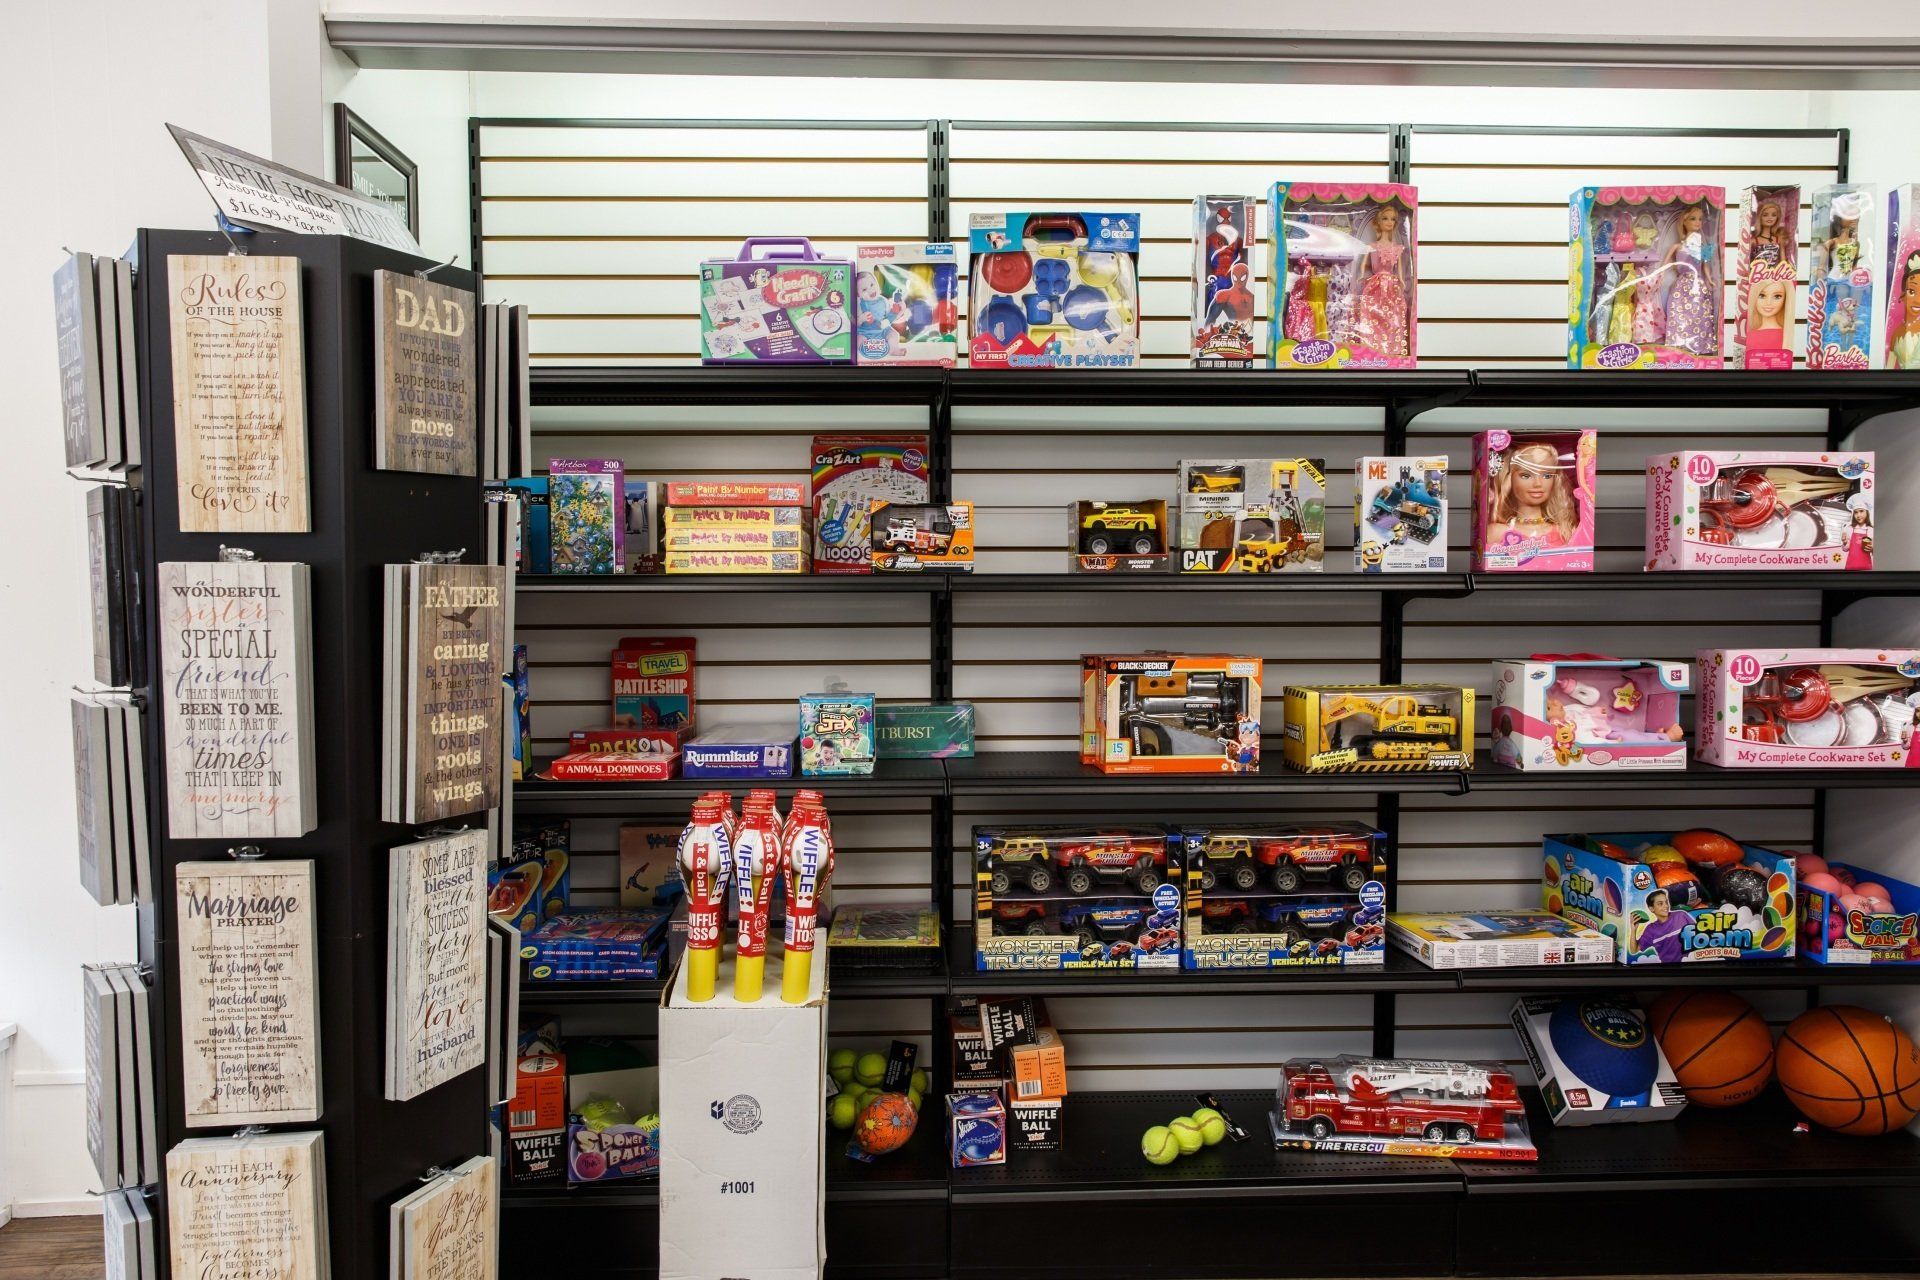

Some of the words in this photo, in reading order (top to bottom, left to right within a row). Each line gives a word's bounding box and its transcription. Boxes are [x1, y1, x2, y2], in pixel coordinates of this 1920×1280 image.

[215, 176, 279, 203] Assorted
[859, 247, 894, 256] Fisher-Price
[1752, 262, 1795, 282] Barbie
[181, 274, 286, 306] Rules
[773, 275, 817, 292] Needle
[186, 307, 203, 315] OF
[208, 307, 234, 315] THE
[240, 308, 282, 316] HOUSE
[395, 289, 465, 337] DAD
[776, 313, 782, 321] 6
[1806, 280, 1827, 369] Barbie
[403, 348, 459, 367] wondered
[1293, 343, 1329, 357] Fashion
[1600, 348, 1635, 358] Fashion
[1825, 346, 1865, 365] Barbie
[1008, 355, 1072, 367] CREATIVE
[1076, 355, 1134, 367] PLAYSET
[1305, 352, 1328, 365] Girls
[1610, 356, 1633, 367] Girls
[411, 419, 454, 437] more
[604, 461, 619, 469] 500
[1369, 464, 1387, 479] ME
[1692, 458, 1711, 475] 10
[1664, 470, 1672, 487] My
[697, 485, 717, 493] Paint
[721, 485, 732, 495] By
[1655, 466, 1664, 532] Cookware
[1662, 491, 1671, 552] Complete
[826, 546, 861, 560] 1000
[1654, 534, 1663, 556] Set
[1184, 551, 1215, 570] CAT
[1695, 553, 1713, 565] My
[1714, 554, 1757, 566] Complete
[1759, 555, 1809, 564] Cookware
[1812, 554, 1828, 564] Set
[173, 587, 280, 597] WONDERFUL
[425, 586, 499, 607] FATHER
[182, 630, 276, 658] SPECIAL
[434, 640, 489, 661] caring
[426, 665, 436, 678] &
[441, 662, 495, 677] LOVING
[645, 658, 683, 670] TRAVEL
[1736, 659, 1754, 675] 10
[432, 679, 442, 689] he
[446, 678, 462, 689] has
[466, 677, 490, 689] given
[1671, 671, 1681, 679] 3+
[185, 689, 207, 699] THAT
[210, 689, 216, 699] IS
[220, 689, 246, 699] WHAT
[250, 689, 278, 699] YOU'VE
[614, 679, 688, 694] BATTLESHIP
[180, 703, 222, 715] BEEN
[228, 703, 249, 715] TO
[255, 703, 282, 715] ME.
[424, 698, 495, 714] IMPORTANT
[186, 719, 195, 730] SO
[199, 719, 224, 730] MUCH
[230, 719, 236, 730] A
[240, 719, 264, 730] PART
[268, 719, 278, 730] OF
[431, 714, 488, 735] things.
[175, 731, 293, 751] wonderful
[439, 735, 464, 750] ONE
[469, 733, 480, 746] IS
[1113, 743, 1123, 753] 15
[195, 747, 272, 769] times
[437, 749, 481, 770] roots
[685, 750, 759, 767] Rummikub
[1738, 751, 1756, 762] My
[1759, 752, 1806, 763] Complete
[1809, 752, 1864, 762] Cookware
[1868, 752, 1885, 762] Set
[567, 765, 604, 773] ANIMAL
[607, 765, 661, 773] DOMINOES
[185, 772, 219, 787] THAT
[224, 772, 227, 786] I
[232, 772, 263, 786] KEEP
[269, 772, 282, 786] IN
[433, 779, 484, 803] wings.
[423, 854, 449, 878] SOME
[453, 846, 474, 870] ARE
[509, 849, 542, 863] MOTOR
[425, 868, 473, 894] blessed
[1570, 874, 1593, 894] air
[188, 891, 299, 923] Marriage
[1562, 880, 1603, 919] foam
[217, 918, 274, 927] PRAYER
[429, 906, 468, 937] SUCCESS
[1696, 912, 1738, 932] air
[1851, 911, 1917, 935] SPONGE
[1194, 937, 1287, 951] MONSTER
[1681, 925, 1752, 950] foam
[1863, 935, 1898, 948] BALL
[984, 939, 1078, 954] MONSTER
[1695, 948, 1719, 958] SPORTS
[1722, 948, 1740, 957] BALL
[984, 954, 1061, 969] TRUCKS
[1193, 952, 1269, 967] TRUCKS
[1305, 957, 1325, 965] PLAY
[1885, 951, 1904, 959] BALL
[209, 960, 223, 973] the
[227, 962, 260, 977] strong
[264, 959, 283, 972] love
[1064, 961, 1096, 969] VEHICLE
[1098, 960, 1118, 969] PLAY
[428, 972, 444, 985] But
[447, 963, 468, 978] more
[208, 991, 257, 1010] practical
[209, 1022, 239, 1037] words
[245, 1022, 257, 1035] be
[262, 1021, 287, 1033] kind
[990, 1006, 1004, 1046] WIFFLE
[1003, 1010, 1015, 1038] BALL
[417, 1026, 475, 1063] husband
[965, 1052, 992, 1061] BALL
[221, 1062, 278, 1077] forgiveness
[1015, 1110, 1057, 1120] WIFFLE
[1022, 1122, 1051, 1131] BALL
[515, 1136, 561, 1150] WIFFLE
[575, 1131, 643, 1152] SPONGE
[1315, 1141, 1342, 1151] FIRE
[1345, 1142, 1390, 1152] RESCUE
[523, 1150, 555, 1161] BALL
[205, 1164, 238, 1174] WITH
[243, 1162, 273, 1172] EACH
[181, 1170, 301, 1189] Anniversary
[721, 1181, 754, 1193] #1001
